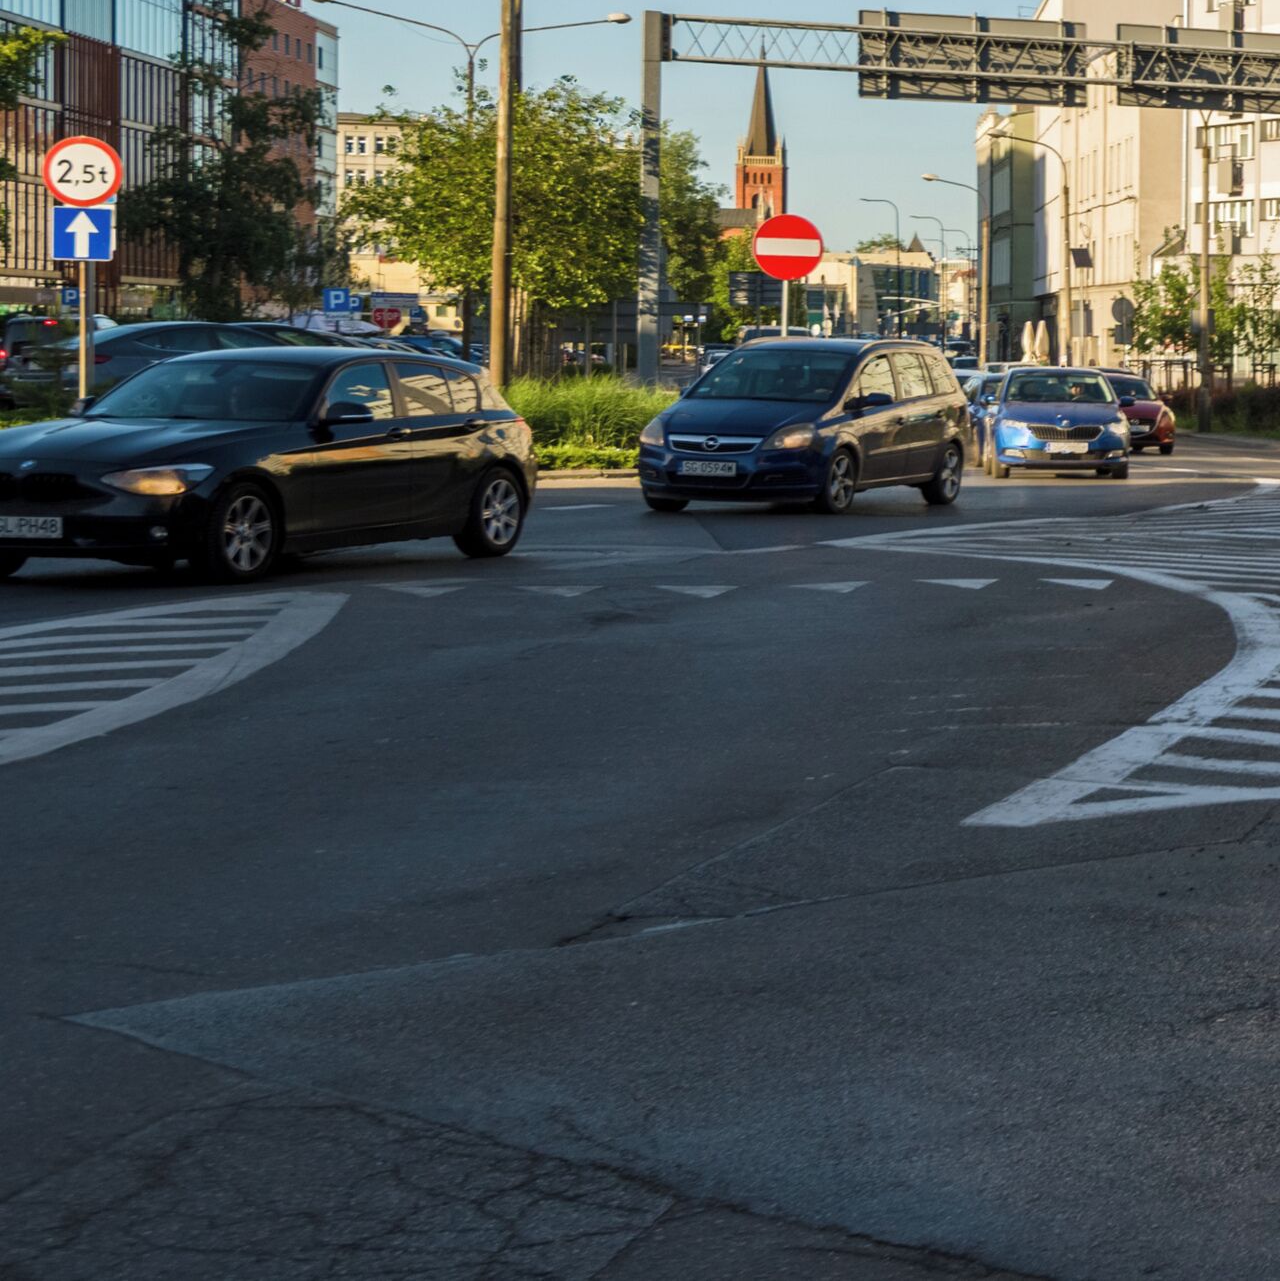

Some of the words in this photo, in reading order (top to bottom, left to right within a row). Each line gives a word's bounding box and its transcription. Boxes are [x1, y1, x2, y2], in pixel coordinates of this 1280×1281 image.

[57, 159, 96, 186] 2,5
[99, 167, 109, 184] t
[66, 290, 77, 303] P
[329, 291, 345, 309] P
[19, 518, 58, 533] PH48
